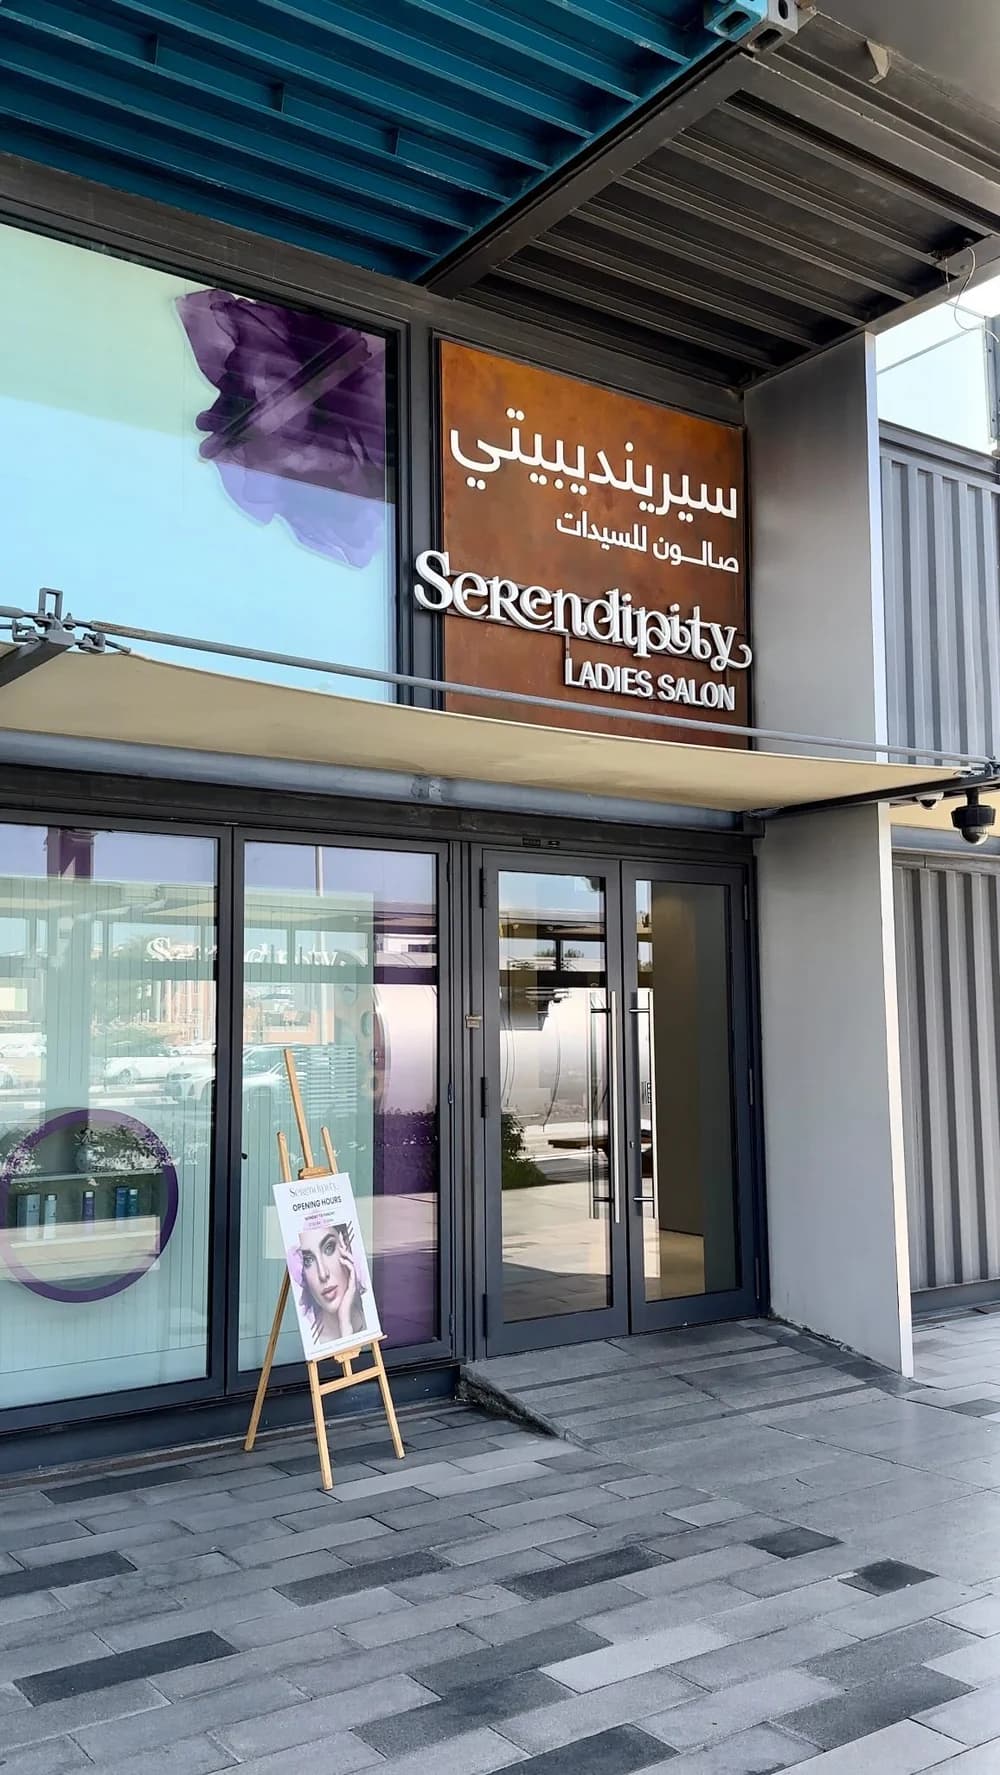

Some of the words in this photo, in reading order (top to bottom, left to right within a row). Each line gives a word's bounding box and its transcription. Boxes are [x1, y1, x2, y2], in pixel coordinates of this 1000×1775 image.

[449, 407, 738, 524] سيرينديبيتي
[555, 510, 647, 552] للسيدات
[564, 657, 654, 699] LADIES
[657, 673, 736, 712] SALON
[292, 1199, 321, 1212] OPENING
[321, 1195, 342, 1207] HOURS
